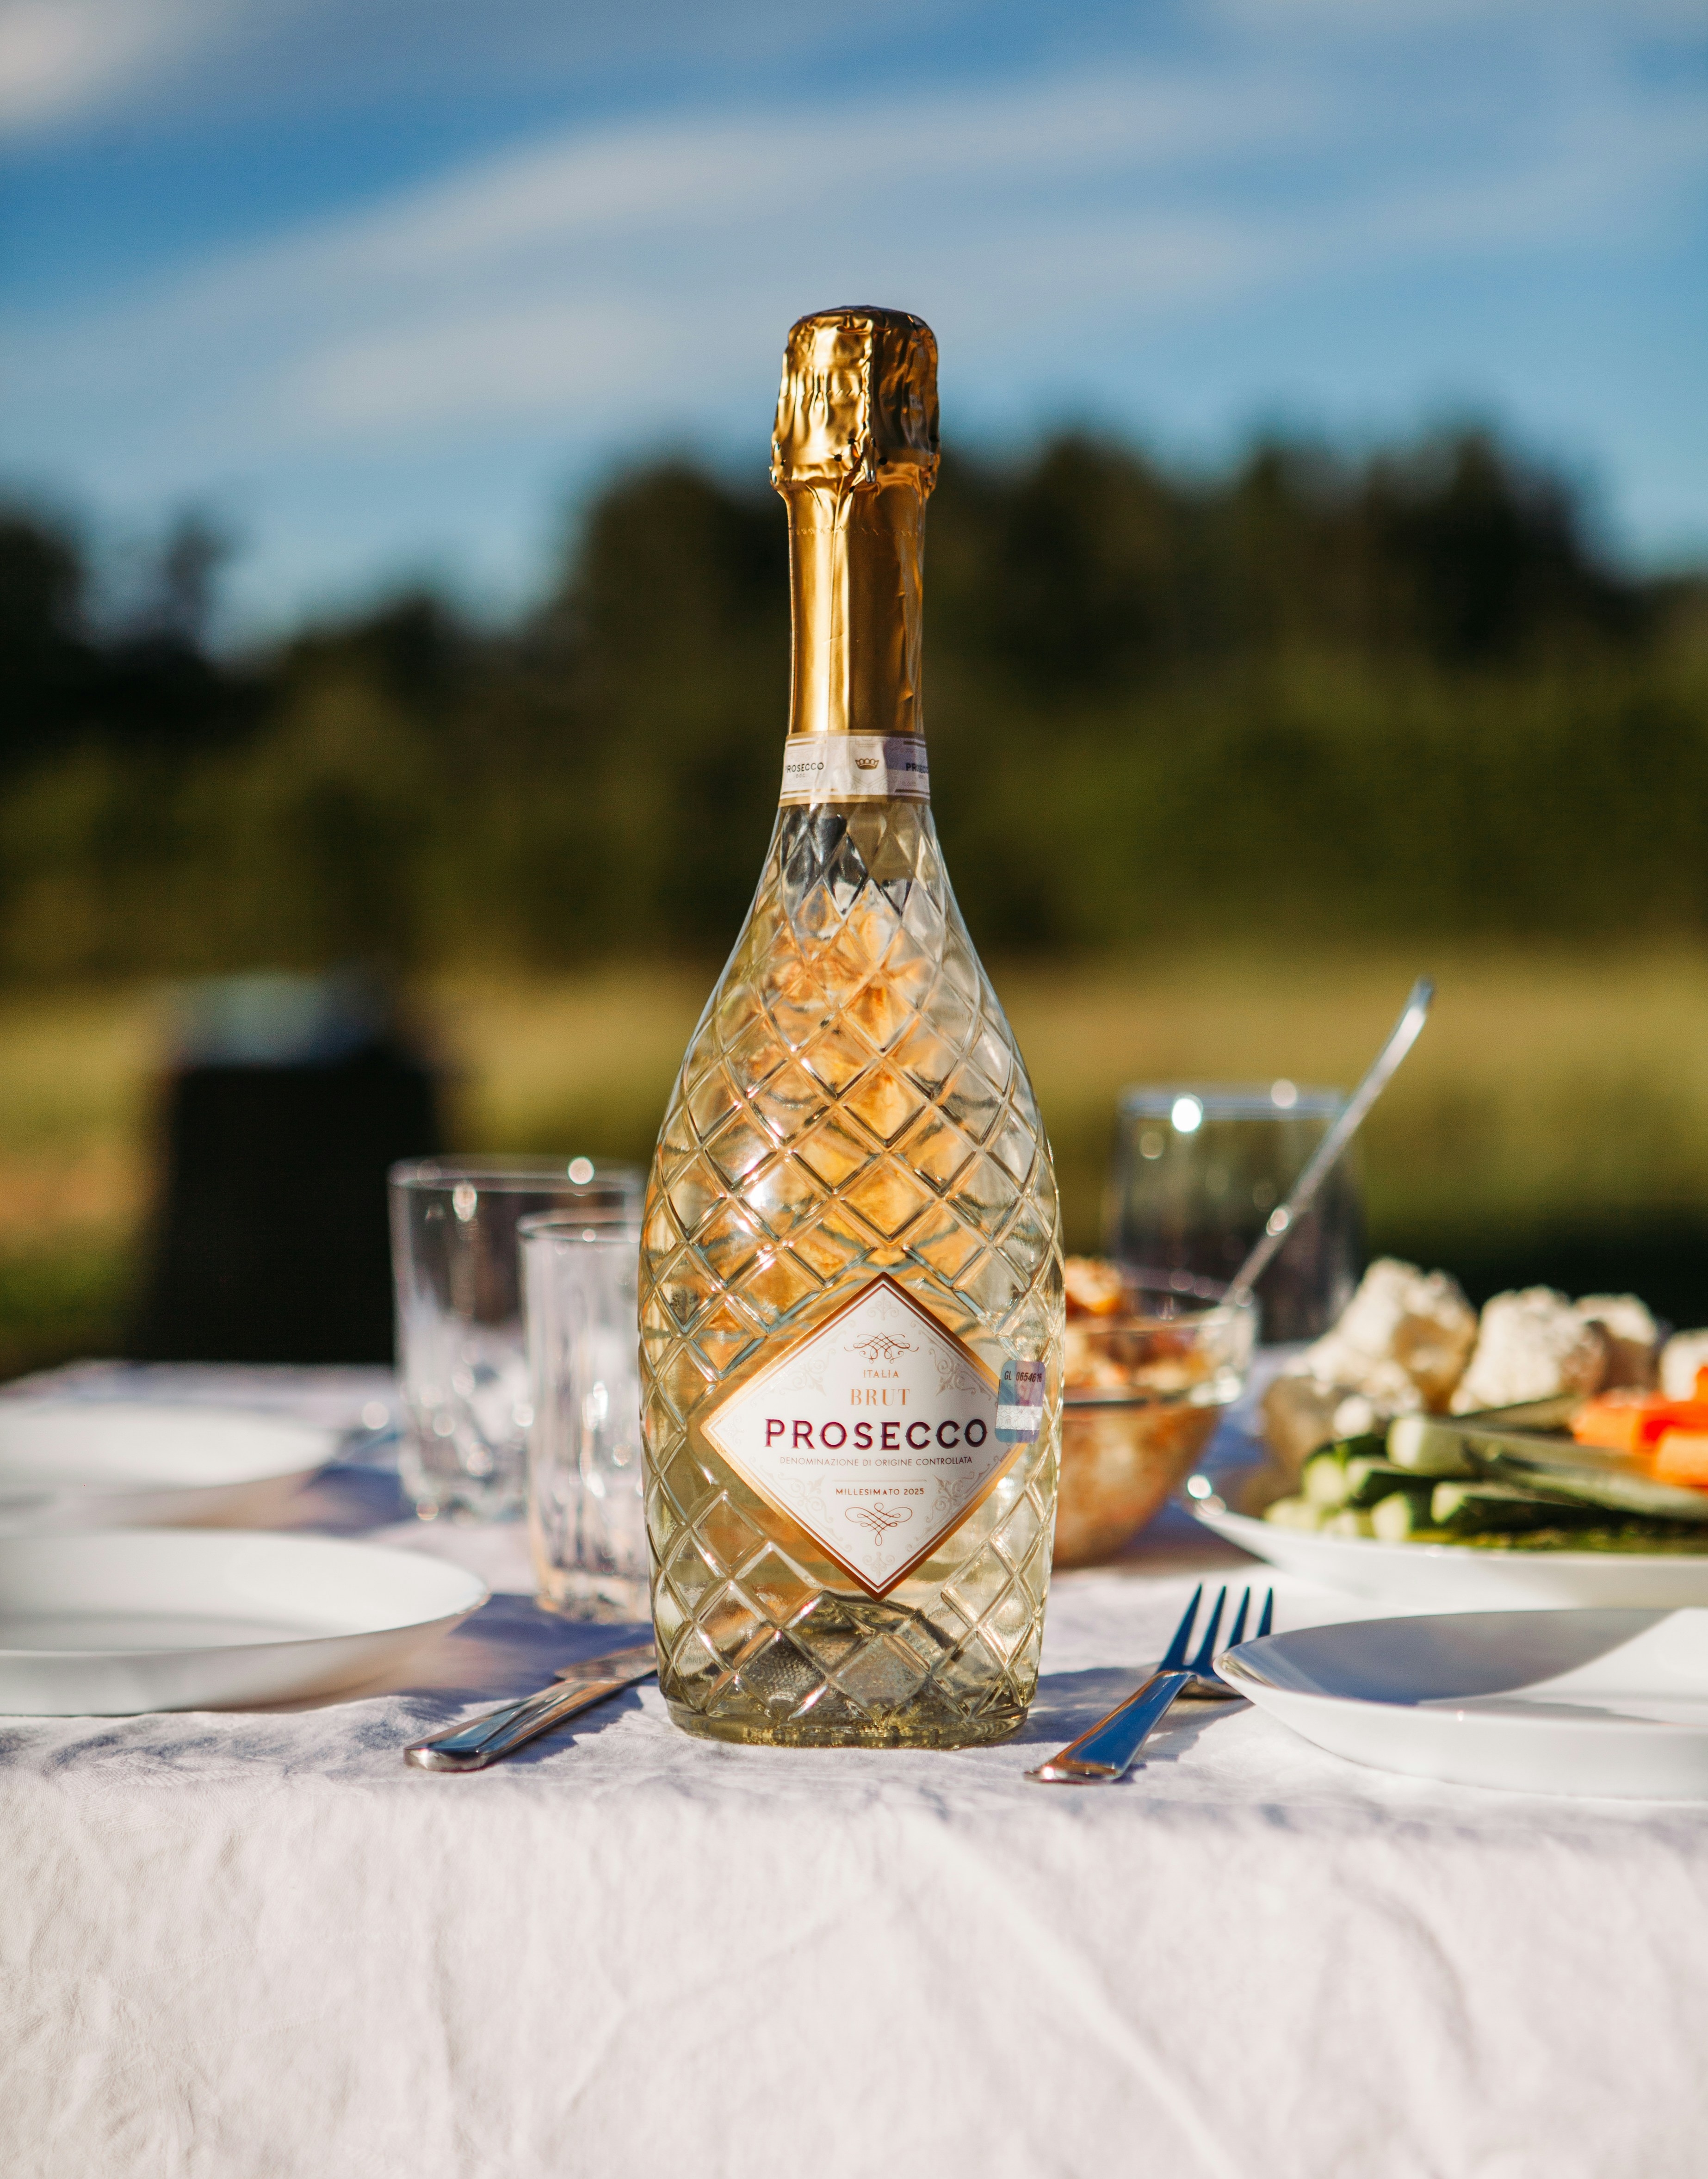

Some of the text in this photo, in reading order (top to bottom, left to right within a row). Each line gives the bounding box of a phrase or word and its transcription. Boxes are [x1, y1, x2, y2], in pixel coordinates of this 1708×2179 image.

[863, 1369, 899, 1378] ITALIA
[1004, 1370, 1012, 1380] GL
[850, 1388, 910, 1406] BRUT
[763, 1418, 988, 1450] PROSECCO
[780, 1456, 859, 1466] DENOMINAZIONE
[916, 1456, 972, 1466] CONTROLLATA
